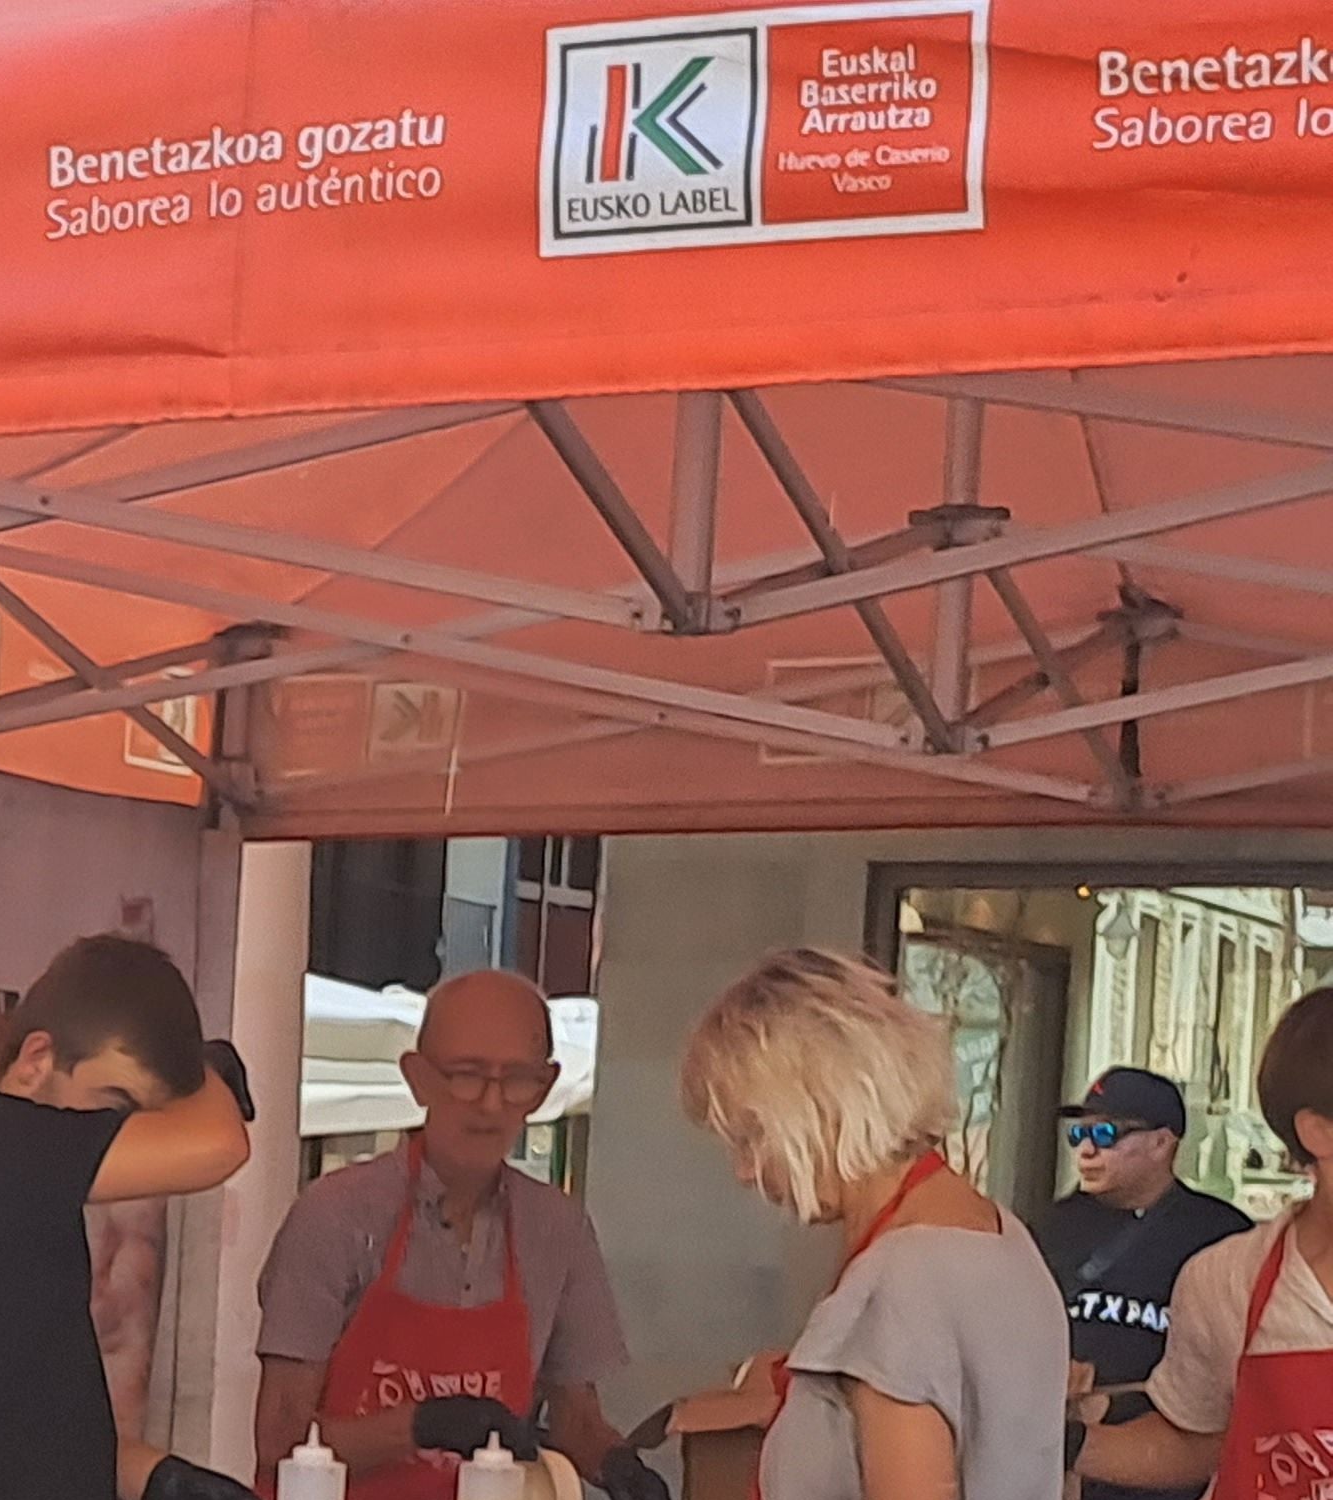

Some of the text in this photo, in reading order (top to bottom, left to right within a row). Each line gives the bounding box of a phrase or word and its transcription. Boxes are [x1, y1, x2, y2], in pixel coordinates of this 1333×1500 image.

[821, 43, 915, 79] Euskal
[1098, 37, 1333, 96] Benetazk
[800, 73, 937, 108] Baserriko
[800, 104, 932, 135] Arrautza
[1092, 105, 1273, 150] Saborea
[47, 108, 445, 188] Benetazkoa gozatu
[845, 149, 871, 168] de
[45, 160, 442, 240] Saborea lo auténtico
[831, 172, 892, 193] Vasco
[567, 186, 738, 222] EUSKO LABEL
